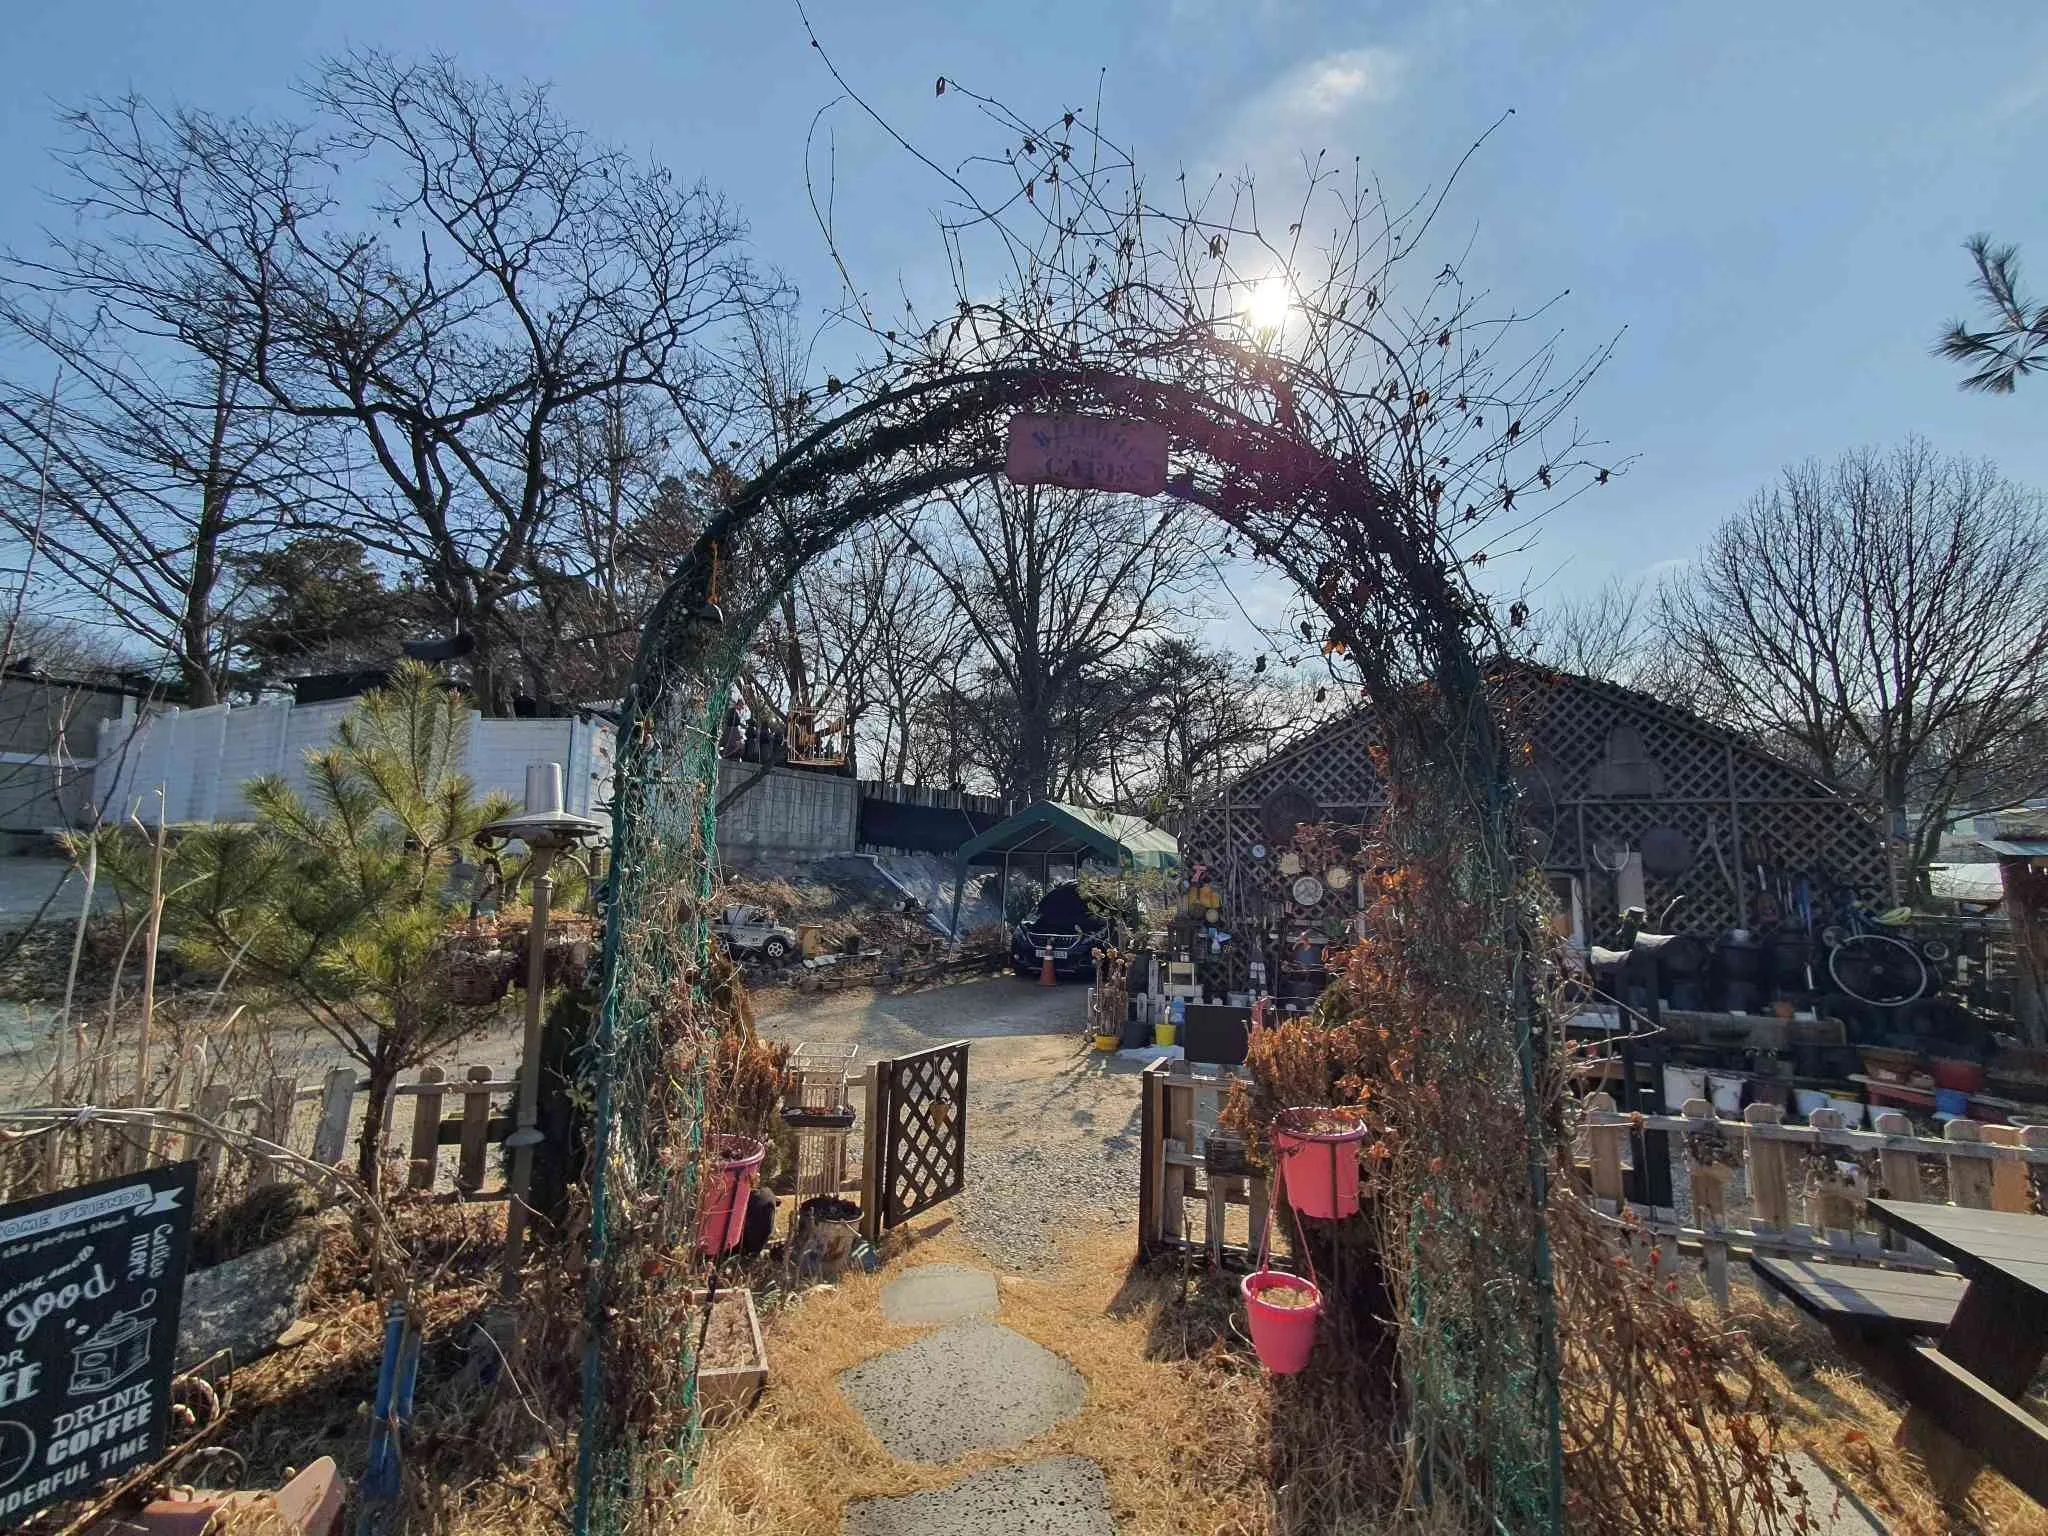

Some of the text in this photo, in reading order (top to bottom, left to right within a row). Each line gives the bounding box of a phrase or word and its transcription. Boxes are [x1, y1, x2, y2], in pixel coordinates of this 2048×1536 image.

[59, 1188, 145, 1220] FRIENDS
[150, 1223, 174, 1279] Coffee
[6, 1263, 117, 1342] good
[46, 1401, 153, 1466] COFFEE
[50, 1378, 154, 1439] DRINK
[100, 1432, 150, 1470] TIME
